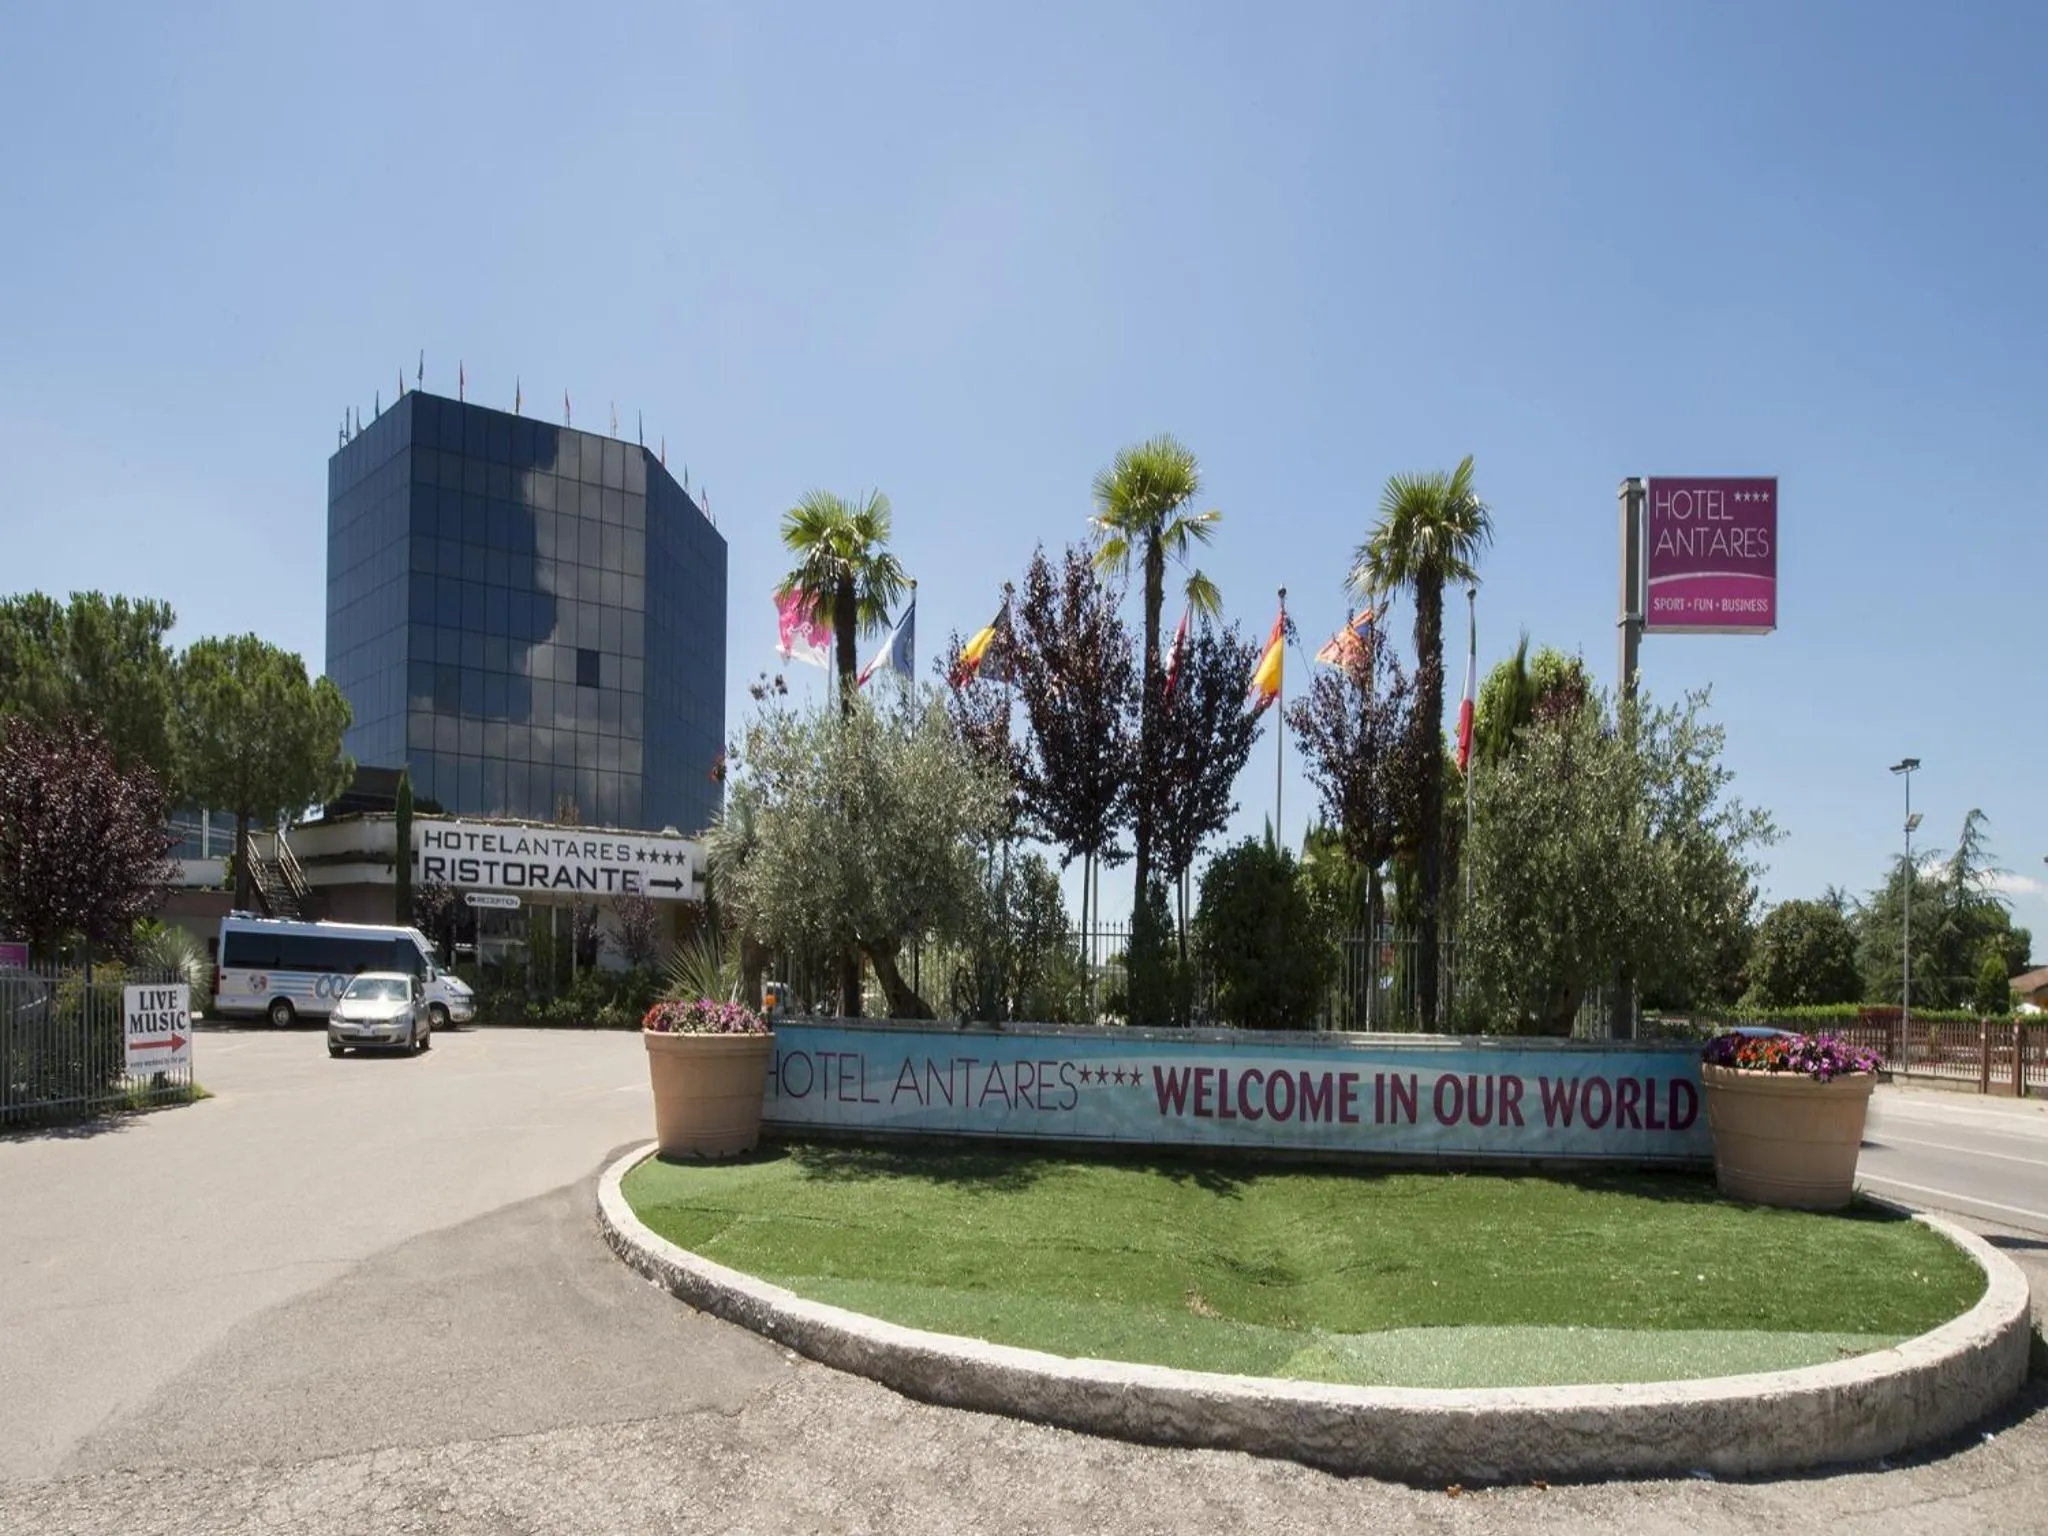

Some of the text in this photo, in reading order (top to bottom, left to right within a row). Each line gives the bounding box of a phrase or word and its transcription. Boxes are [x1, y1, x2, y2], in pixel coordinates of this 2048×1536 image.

[1655, 489, 1734, 521] HOTEL
[1654, 527, 1769, 559] ANTARES
[1653, 597, 1769, 613] SPORT FUN BUSINESS
[424, 856, 640, 893] RISTORANTE
[139, 990, 178, 1011] LIVE
[129, 1011, 187, 1034] MUSIC
[891, 1056, 1079, 1112] ANTARES
[1153, 1065, 1360, 1124] WELCOME
[1375, 1073, 1418, 1125] IN
[1433, 1073, 1525, 1128] OUR
[1540, 1076, 1699, 1132] WORLD
